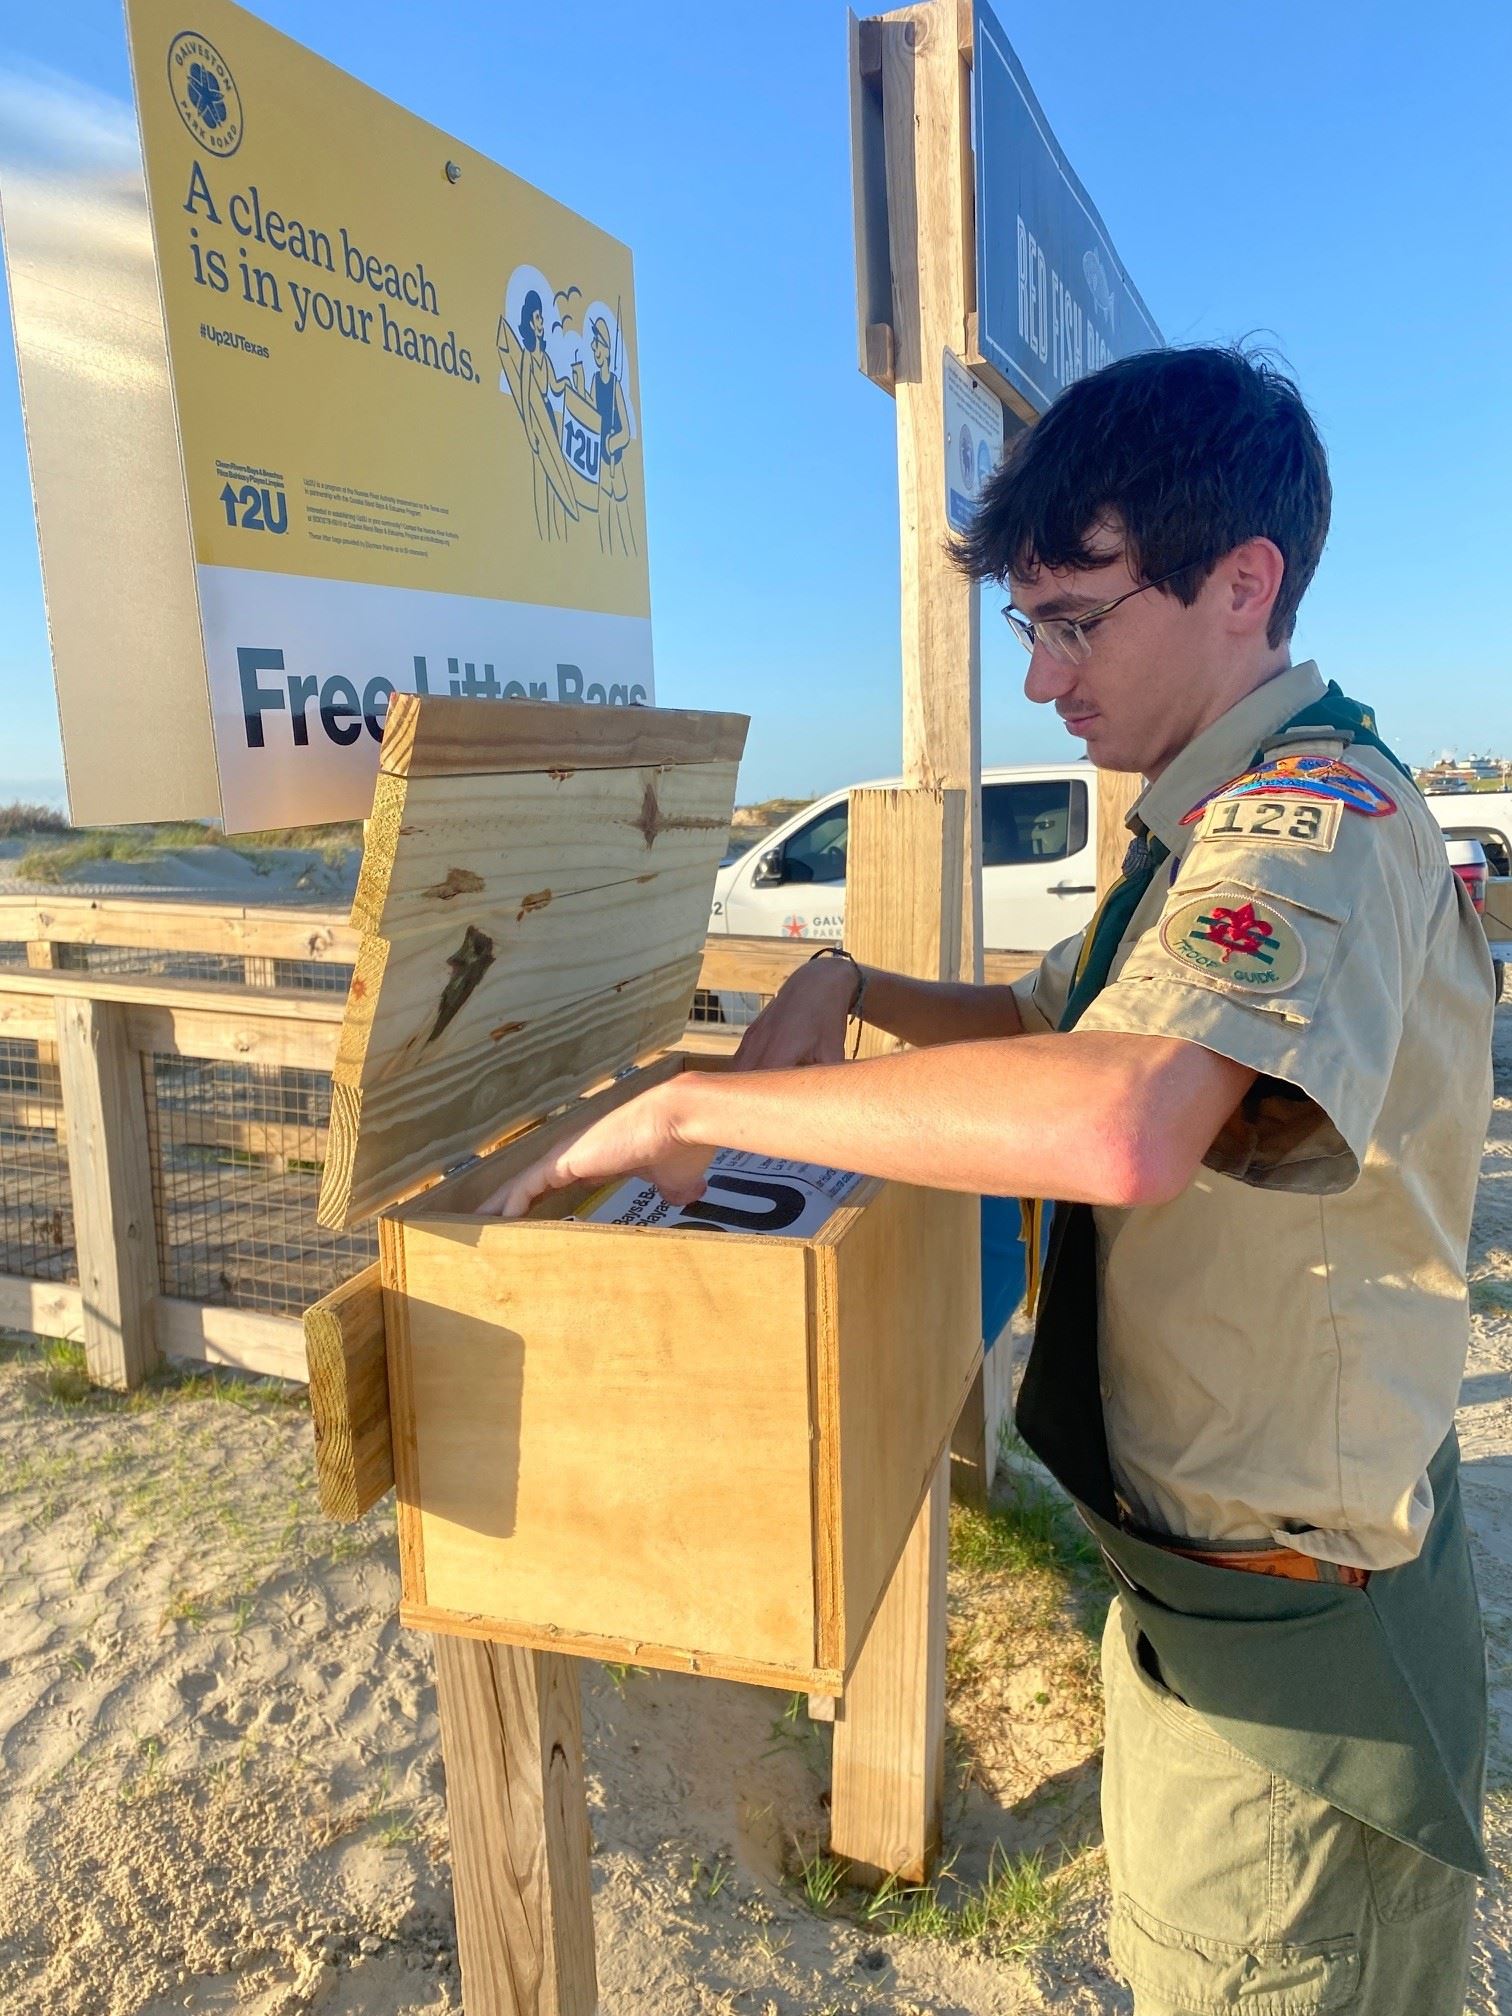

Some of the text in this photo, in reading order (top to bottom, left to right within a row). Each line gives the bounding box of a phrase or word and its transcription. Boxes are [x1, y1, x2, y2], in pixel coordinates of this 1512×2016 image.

[175, 41, 232, 92] GALVESTON
[181, 99, 237, 148] PARK BOARD
[184, 160, 440, 317] A clean beach
[190, 227, 481, 384] is in your hands.
[1016, 213, 1083, 388] RED FISH
[200, 322, 270, 359] #Up2UTexas
[236, 646, 395, 748] Free
[1212, 802, 1322, 840] 123
[1172, 938, 1279, 985] TROOP GUIDE
